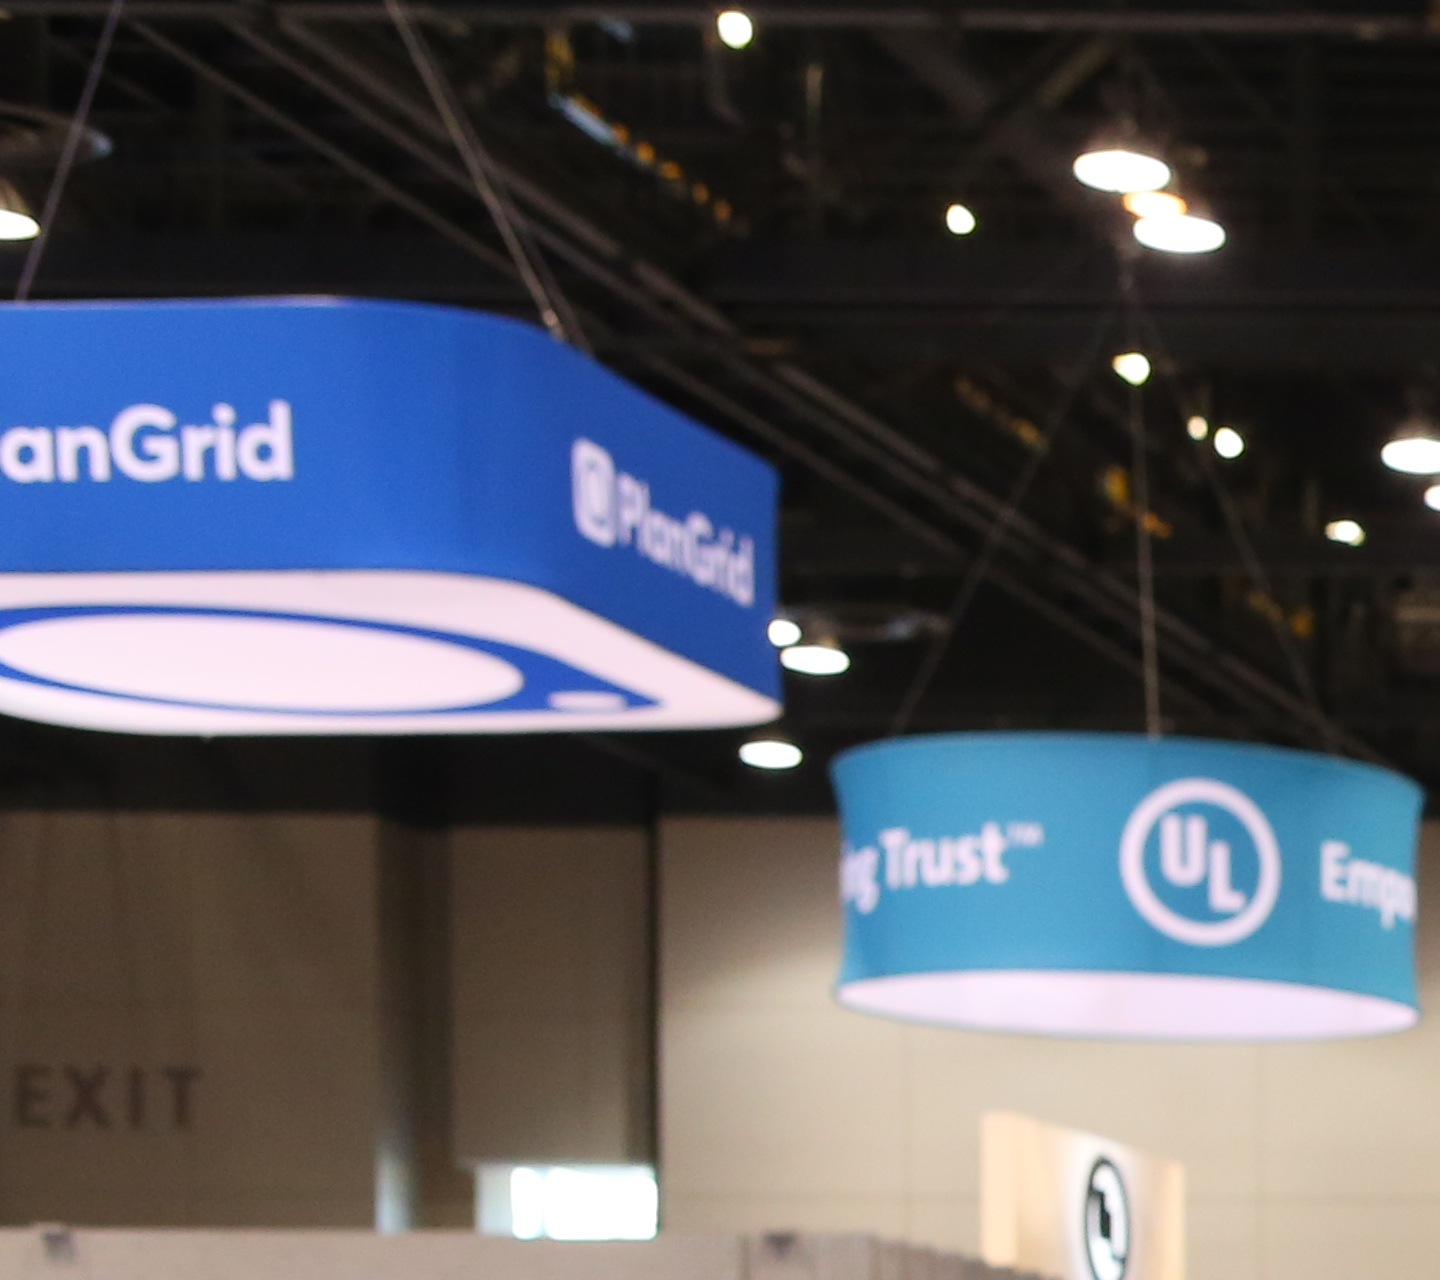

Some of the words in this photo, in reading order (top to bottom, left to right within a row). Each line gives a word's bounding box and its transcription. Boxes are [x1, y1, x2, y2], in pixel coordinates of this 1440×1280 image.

[617, 472, 755, 607] PlanGrid
[1158, 813, 1246, 915] UL
[12, 1064, 204, 1129] EXIT
